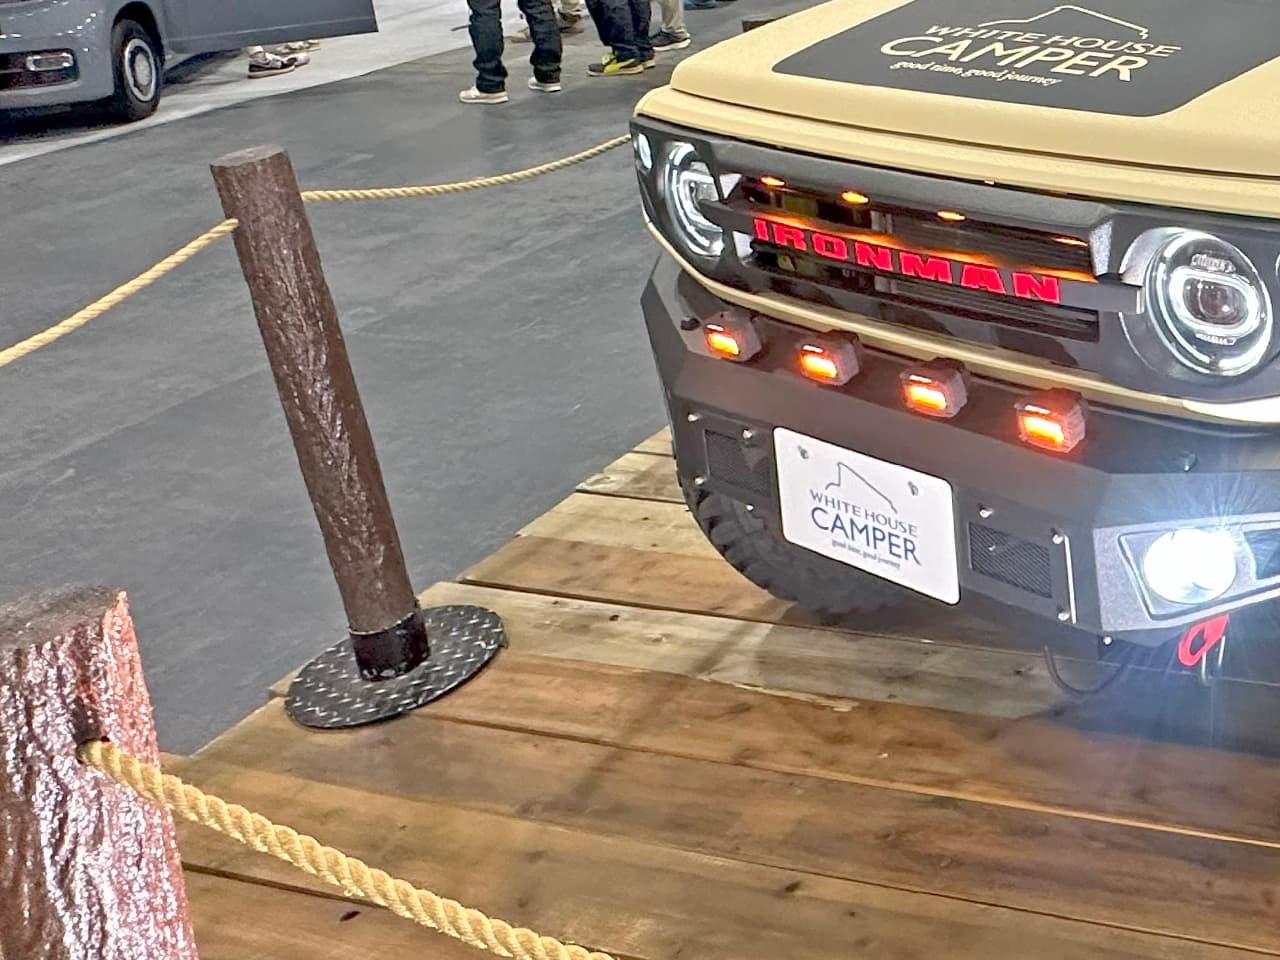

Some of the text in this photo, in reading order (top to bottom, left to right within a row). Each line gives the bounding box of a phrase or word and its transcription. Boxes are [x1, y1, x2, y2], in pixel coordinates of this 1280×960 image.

[880, 37, 1148, 81] CAMPER
[924, 25, 1182, 57] WHITE HOUSE
[889, 61, 934, 71] good
[1000, 70, 1063, 87] journey
[753, 218, 1060, 304] IRONMAN
[810, 489, 918, 537] WHITE HOUSE
[811, 506, 922, 566] CAMPER
